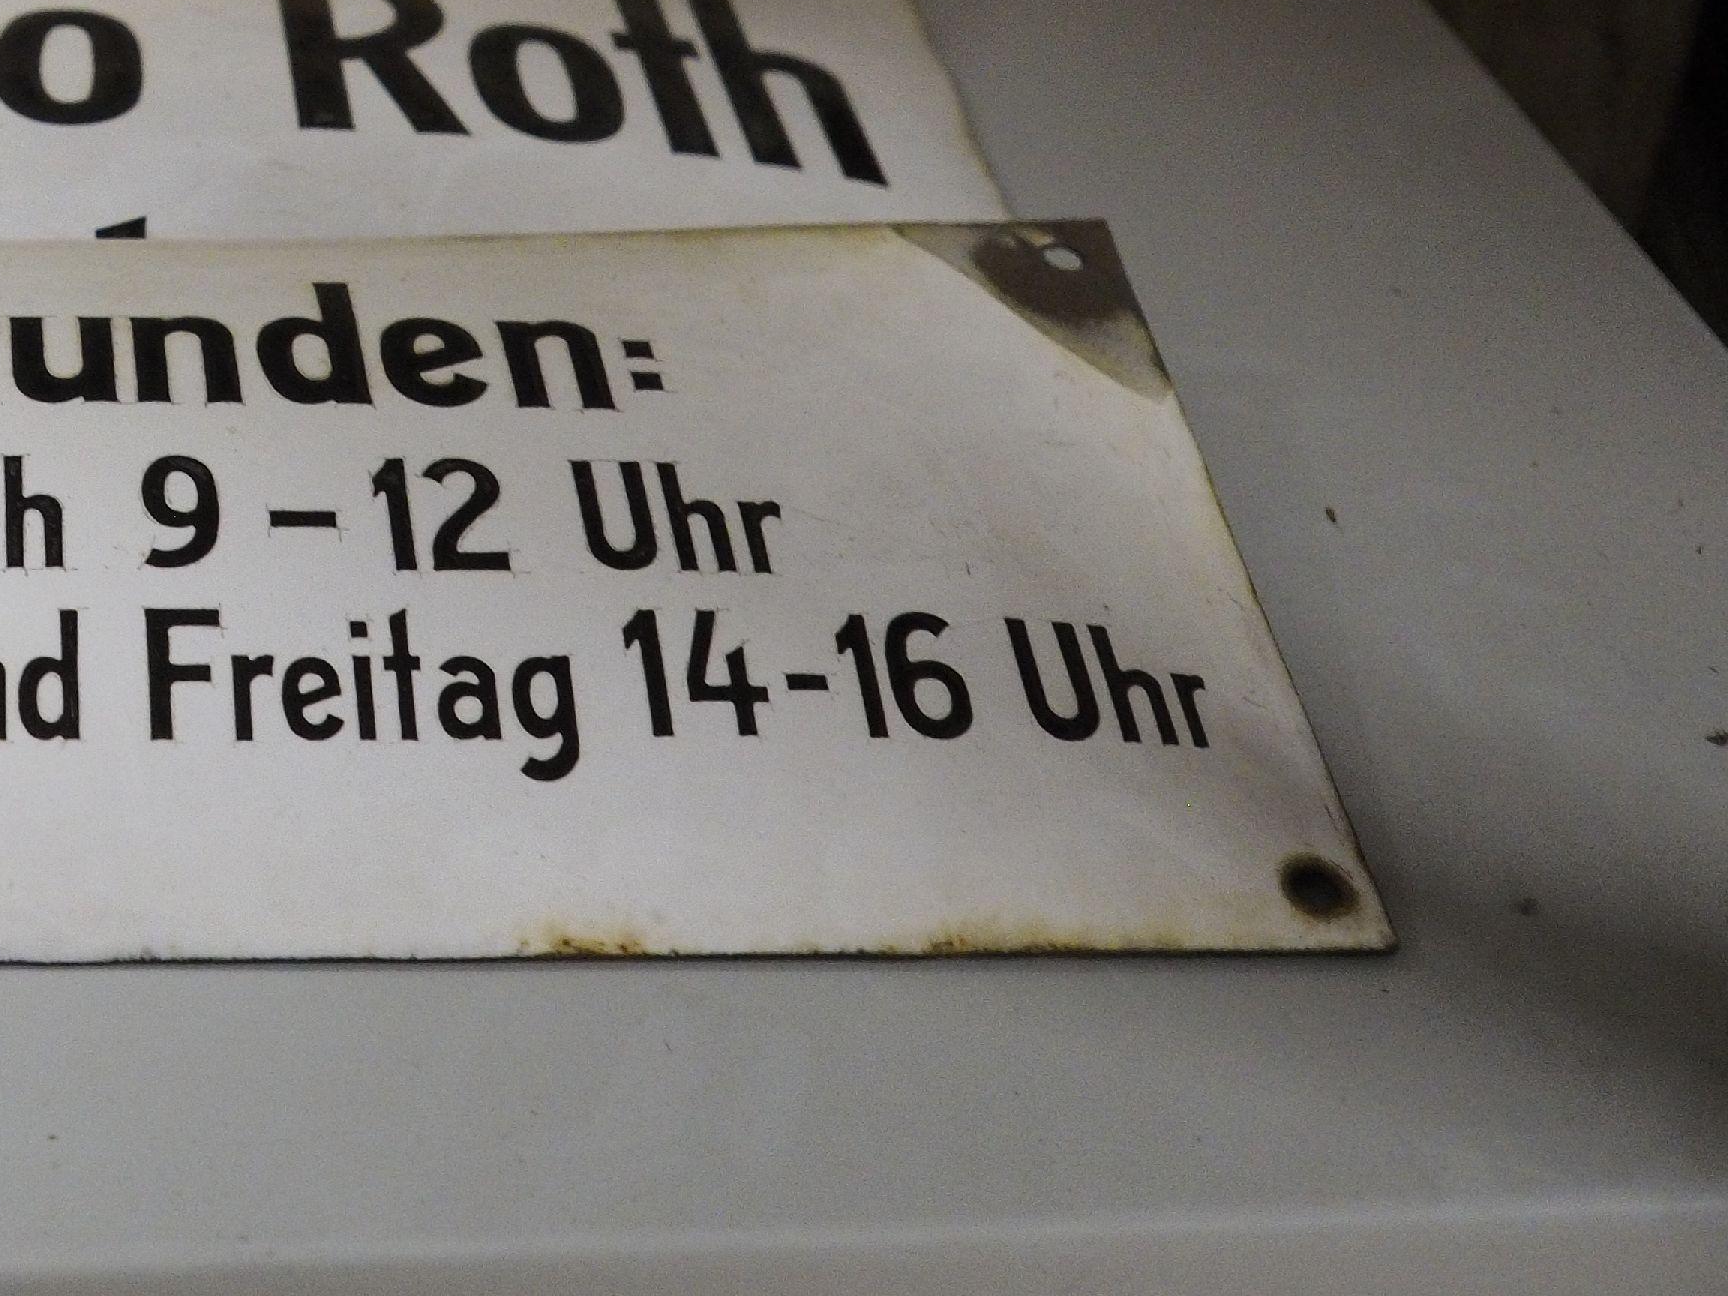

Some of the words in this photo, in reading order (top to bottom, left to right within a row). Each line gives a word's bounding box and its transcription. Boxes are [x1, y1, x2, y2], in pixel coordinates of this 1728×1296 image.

[141, 455, 219, 568] 9
[372, 458, 511, 571] 12
[571, 461, 780, 573] Uhr
[145, 608, 579, 781] Freitag
[623, 610, 973, 740] 14-16
[1005, 618, 1209, 748] Uhr
